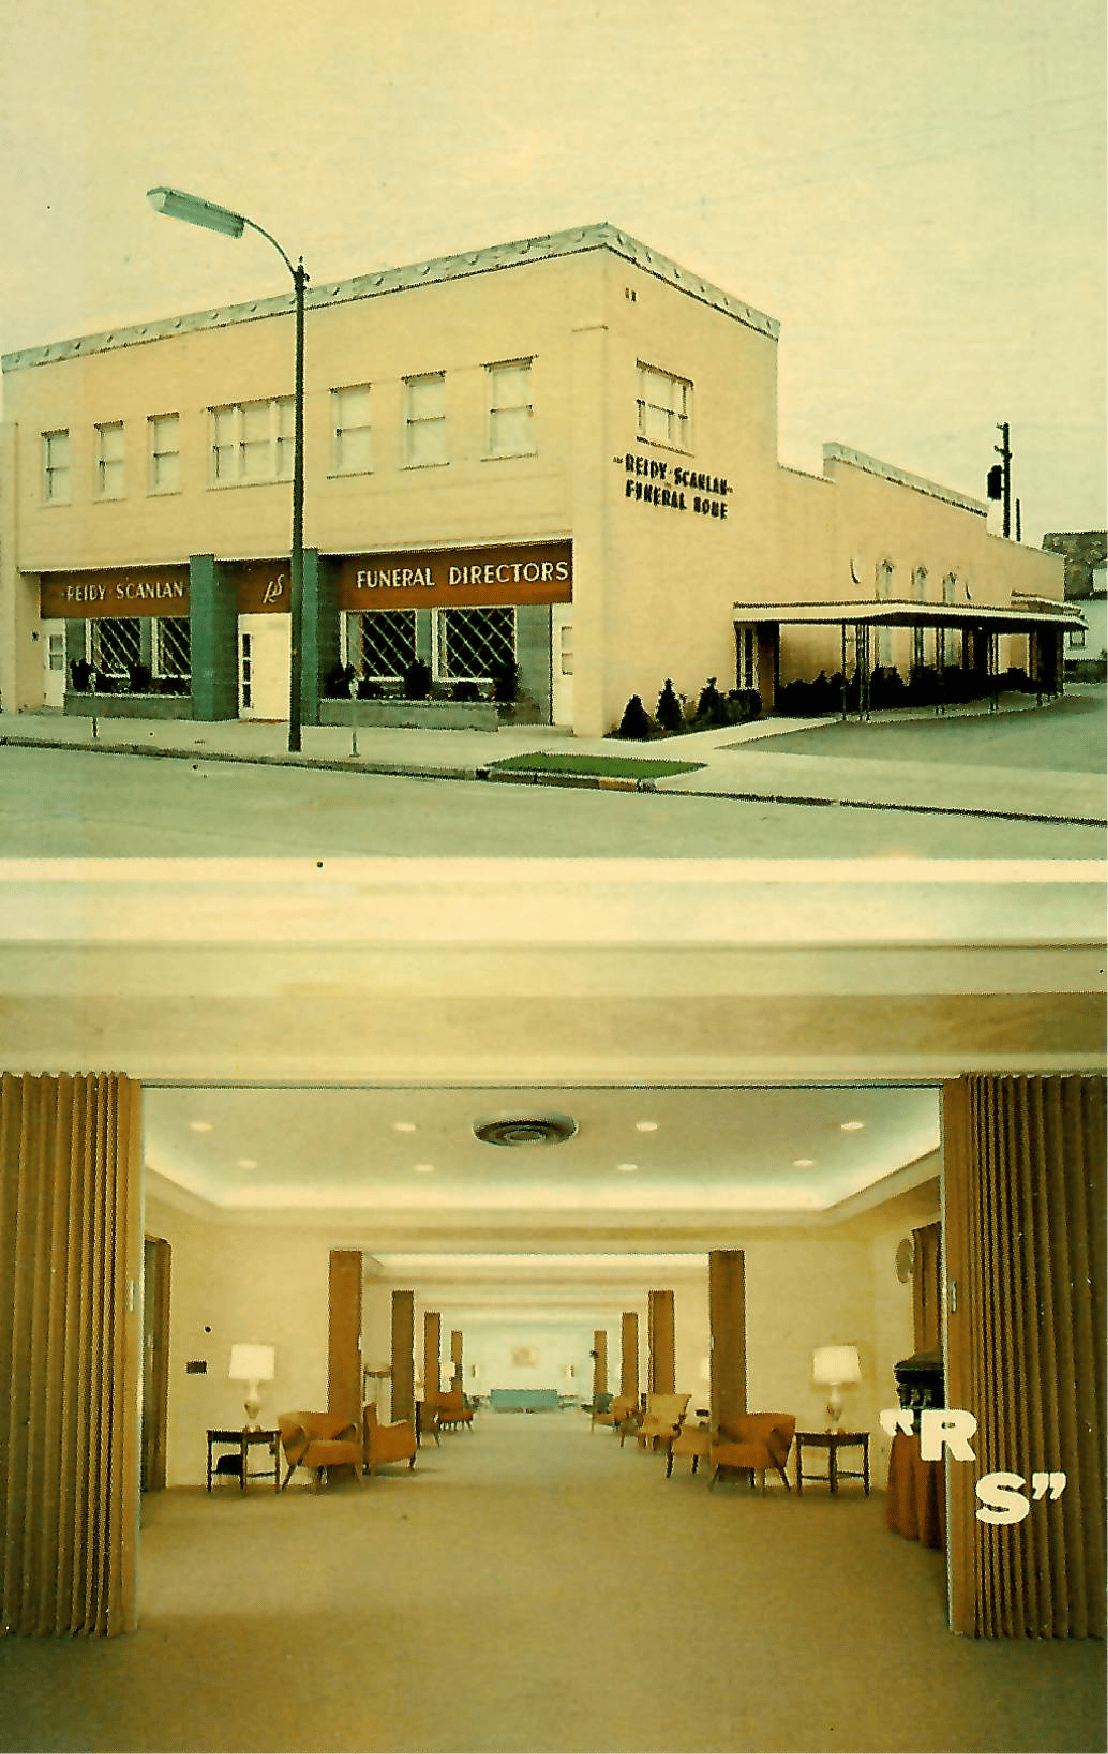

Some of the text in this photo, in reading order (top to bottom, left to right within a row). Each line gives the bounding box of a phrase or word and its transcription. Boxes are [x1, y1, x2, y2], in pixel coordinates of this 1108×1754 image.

[625, 479, 687, 511] FUNERAL
[356, 561, 569, 588] FUNERAL DIRECTORS
[115, 581, 183, 599] SCANLAN
